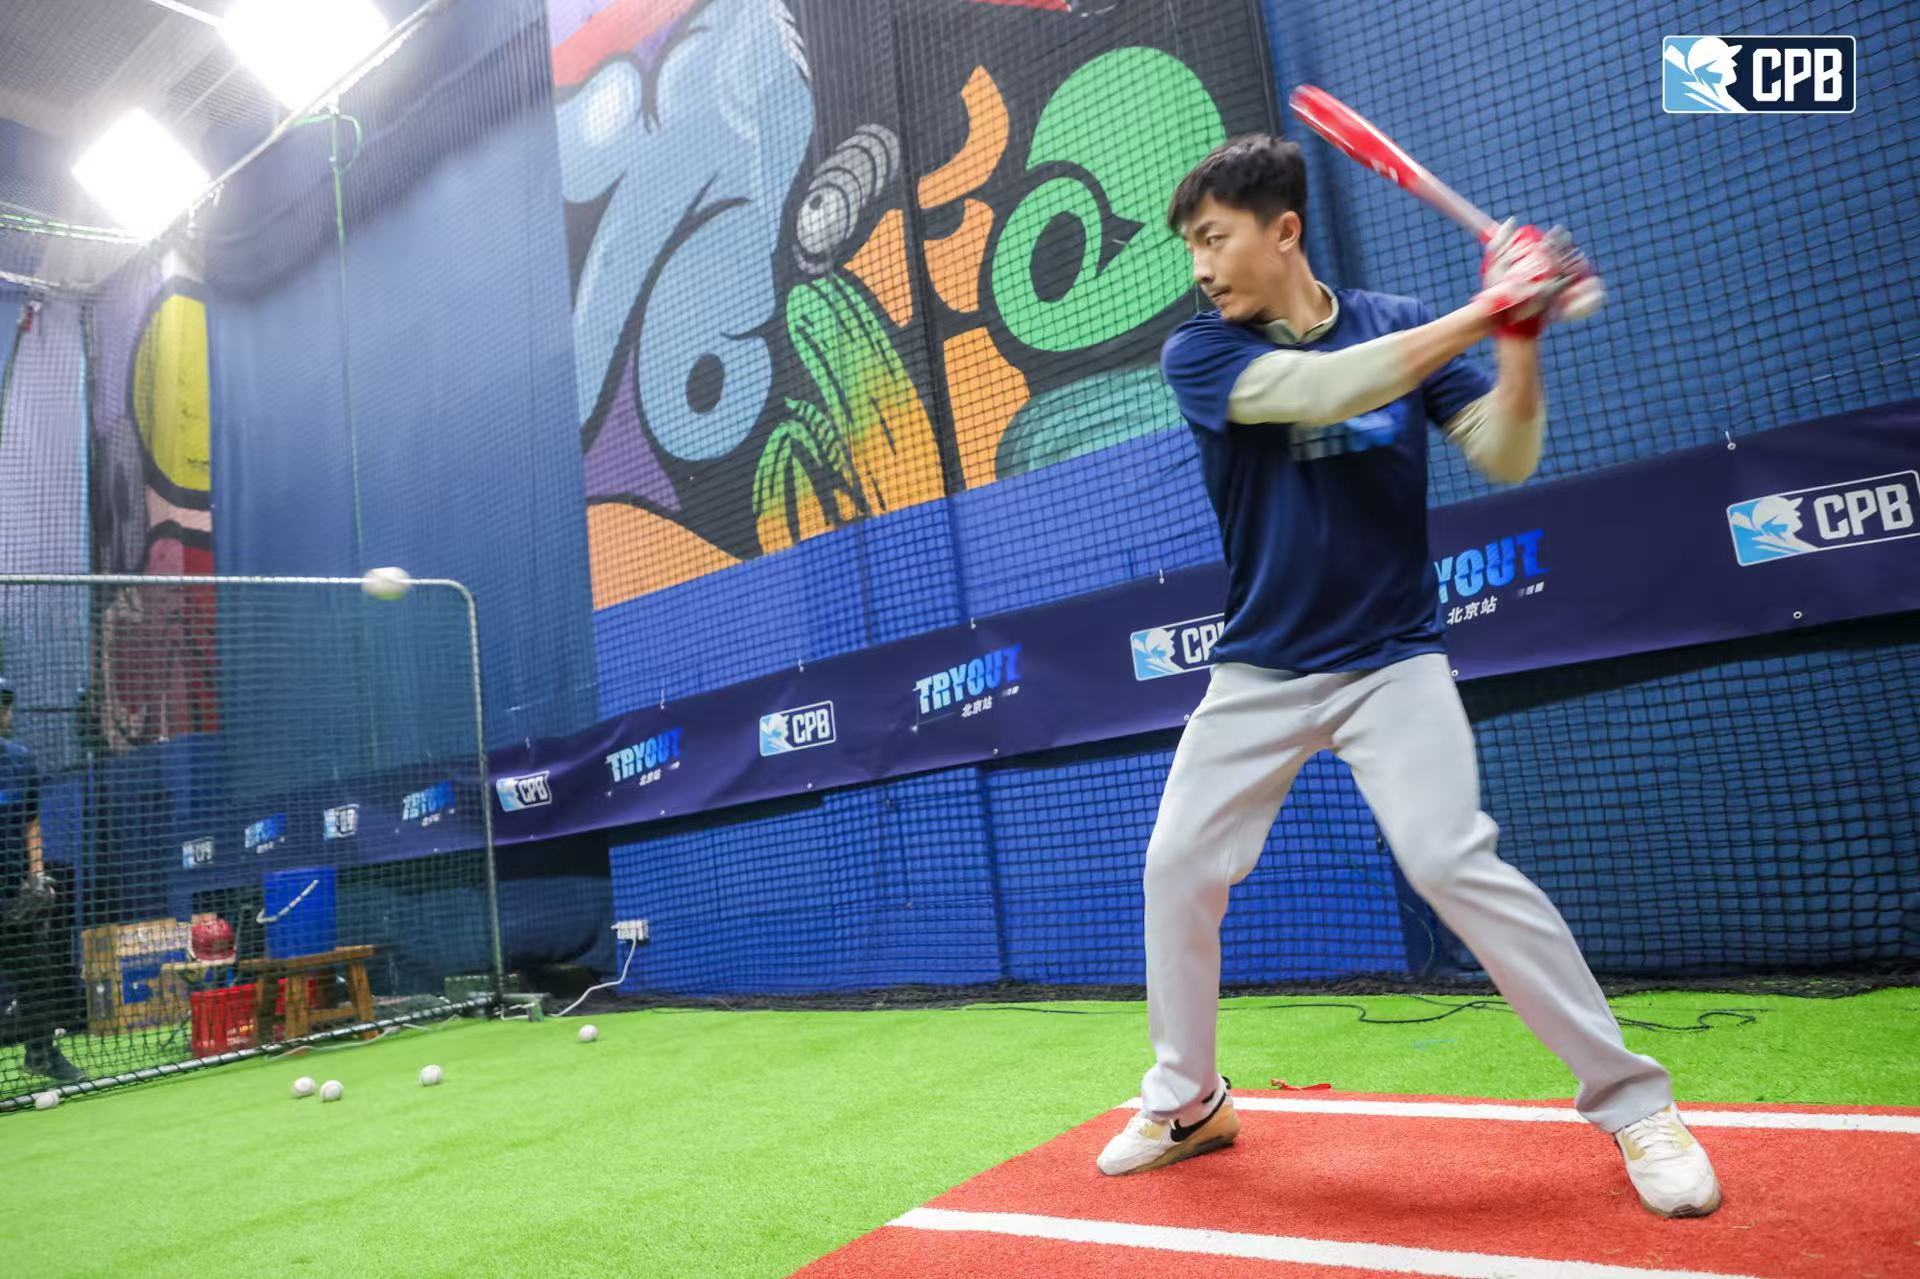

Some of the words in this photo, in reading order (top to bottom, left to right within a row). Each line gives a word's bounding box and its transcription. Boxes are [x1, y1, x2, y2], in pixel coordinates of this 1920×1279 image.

[1813, 483, 1914, 540] CPB
[1434, 528, 1550, 604] YOUT
[1446, 595, 1498, 625] 北京站
[912, 643, 1022, 714] TRYOUT
[792, 708, 831, 744] CPB
[605, 728, 682, 783] TRYOUT
